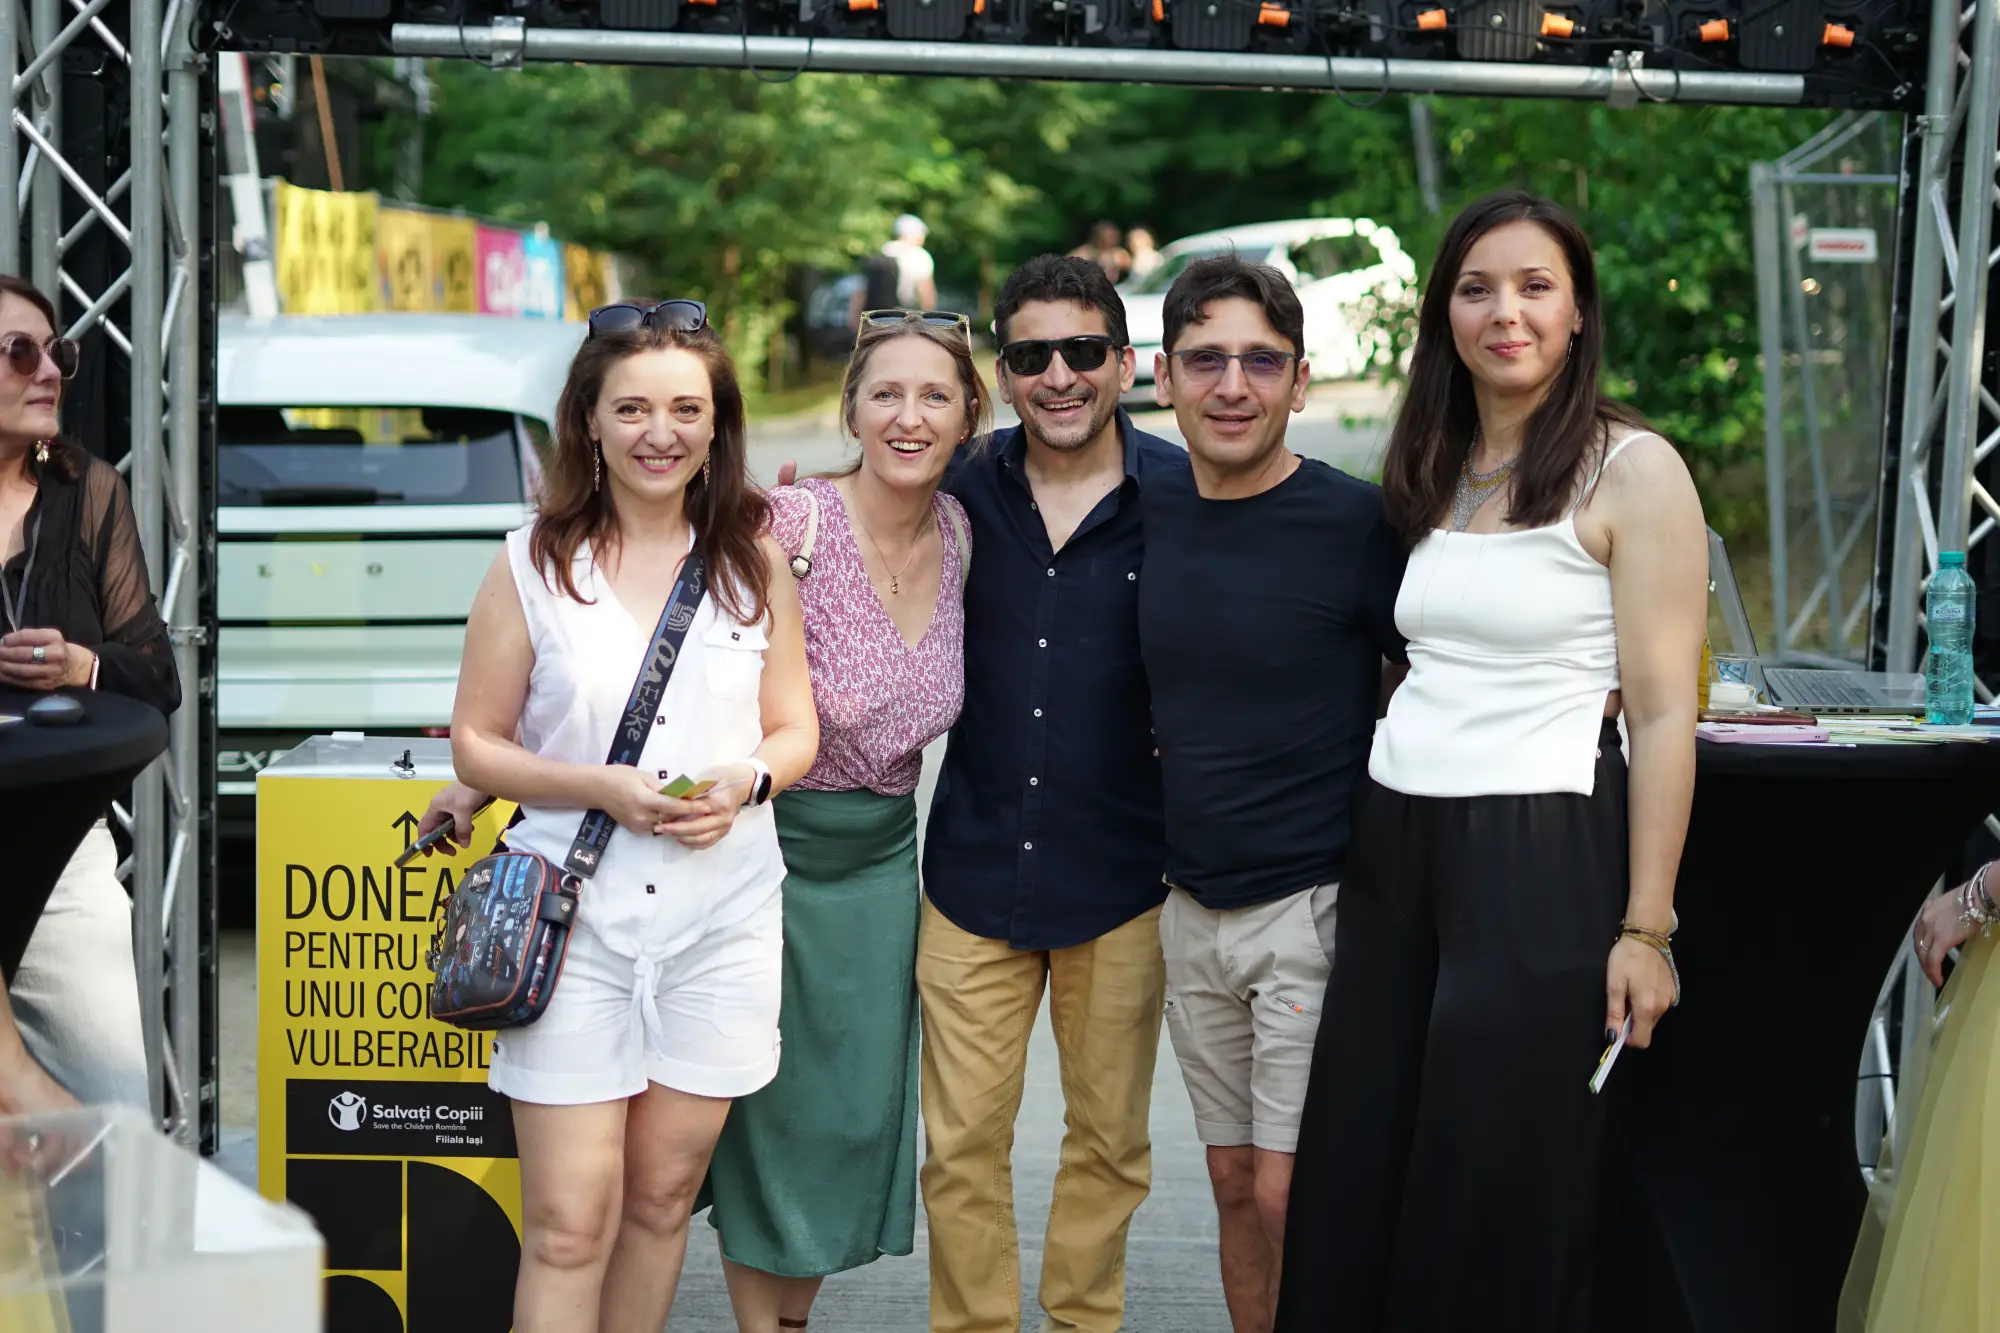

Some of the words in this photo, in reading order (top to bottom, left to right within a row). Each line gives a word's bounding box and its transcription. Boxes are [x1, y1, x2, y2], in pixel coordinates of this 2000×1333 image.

[286, 864, 470, 922] DONEA
[286, 931, 417, 970] PENTRU
[286, 980, 364, 1018] UNUI
[286, 1028, 490, 1069] VULBERABIL
[373, 1122, 390, 1130] Save
[435, 1123, 467, 1131] România
[435, 1105, 483, 1124] Copiii
[435, 1135, 464, 1144] Filiala
[466, 1136, 483, 1146] Iași
